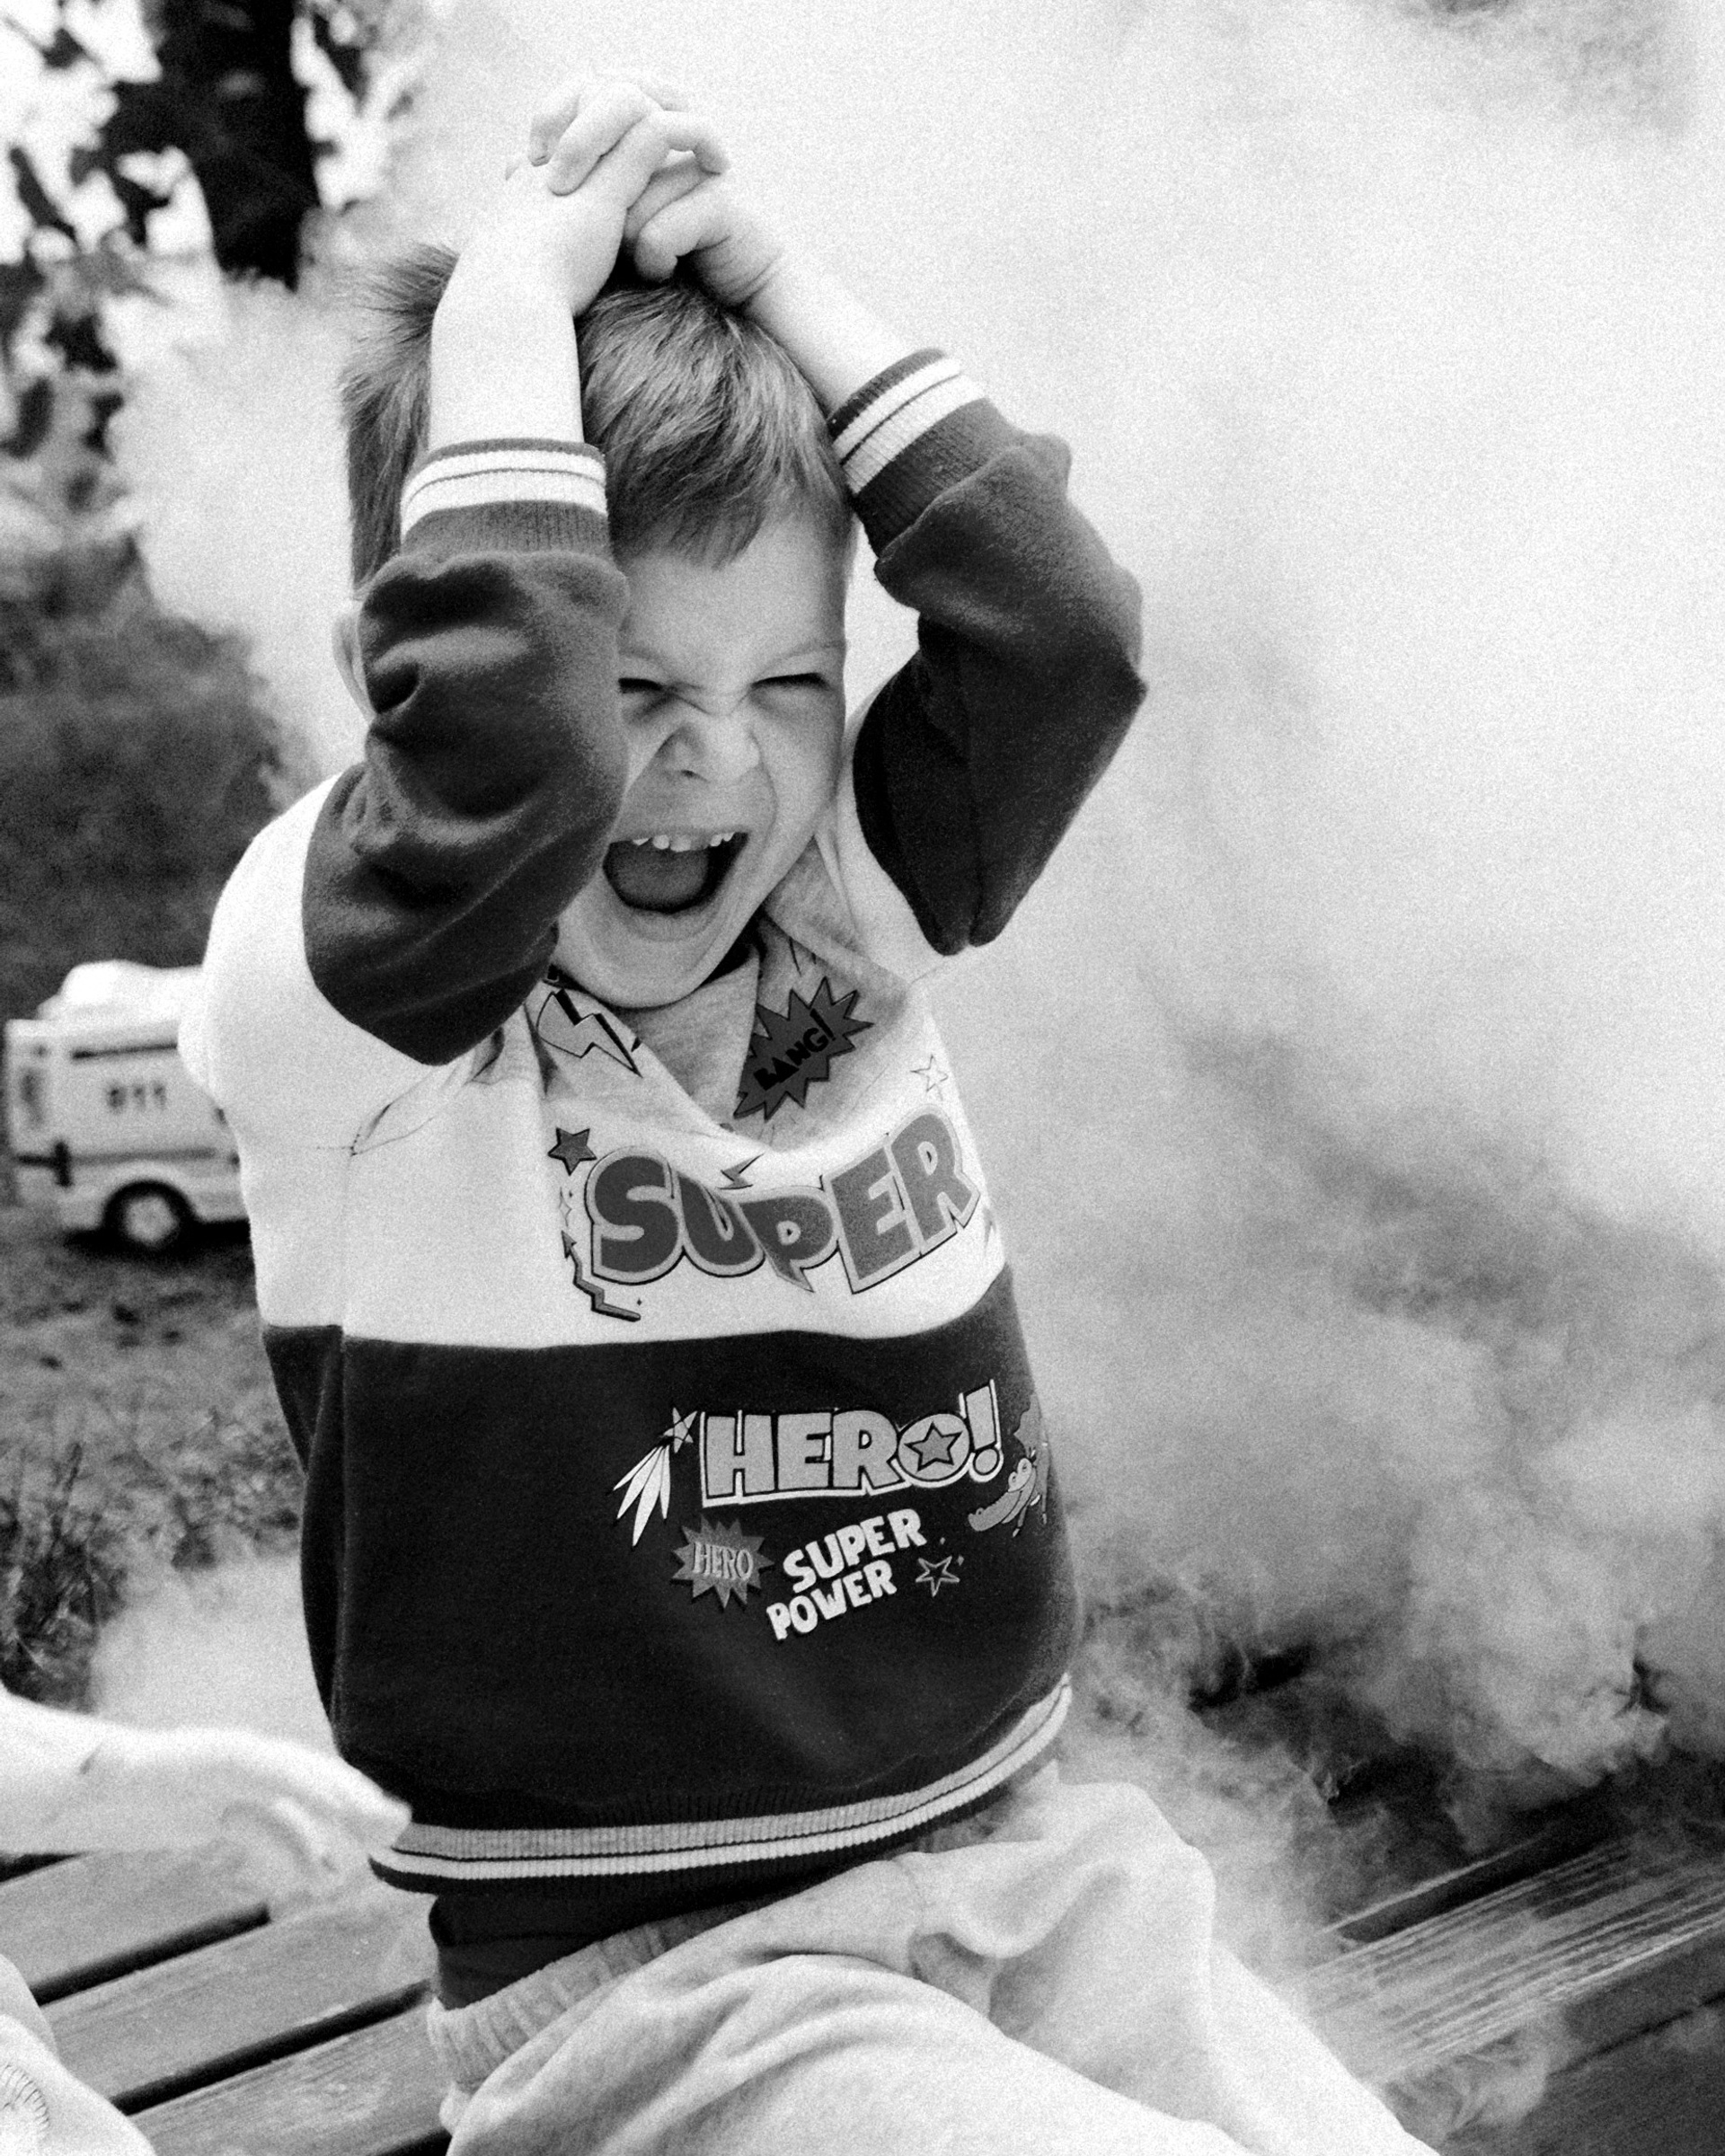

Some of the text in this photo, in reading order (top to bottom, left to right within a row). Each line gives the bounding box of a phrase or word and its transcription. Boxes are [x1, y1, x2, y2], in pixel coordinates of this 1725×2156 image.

[753, 1008, 836, 1091] BANG!
[585, 1106, 980, 1294] SUPER
[699, 1379, 1004, 1507] HERO!
[693, 1542, 754, 1581] HERO
[783, 1508, 927, 1594] SUPER
[766, 1560, 897, 1640] POWER
